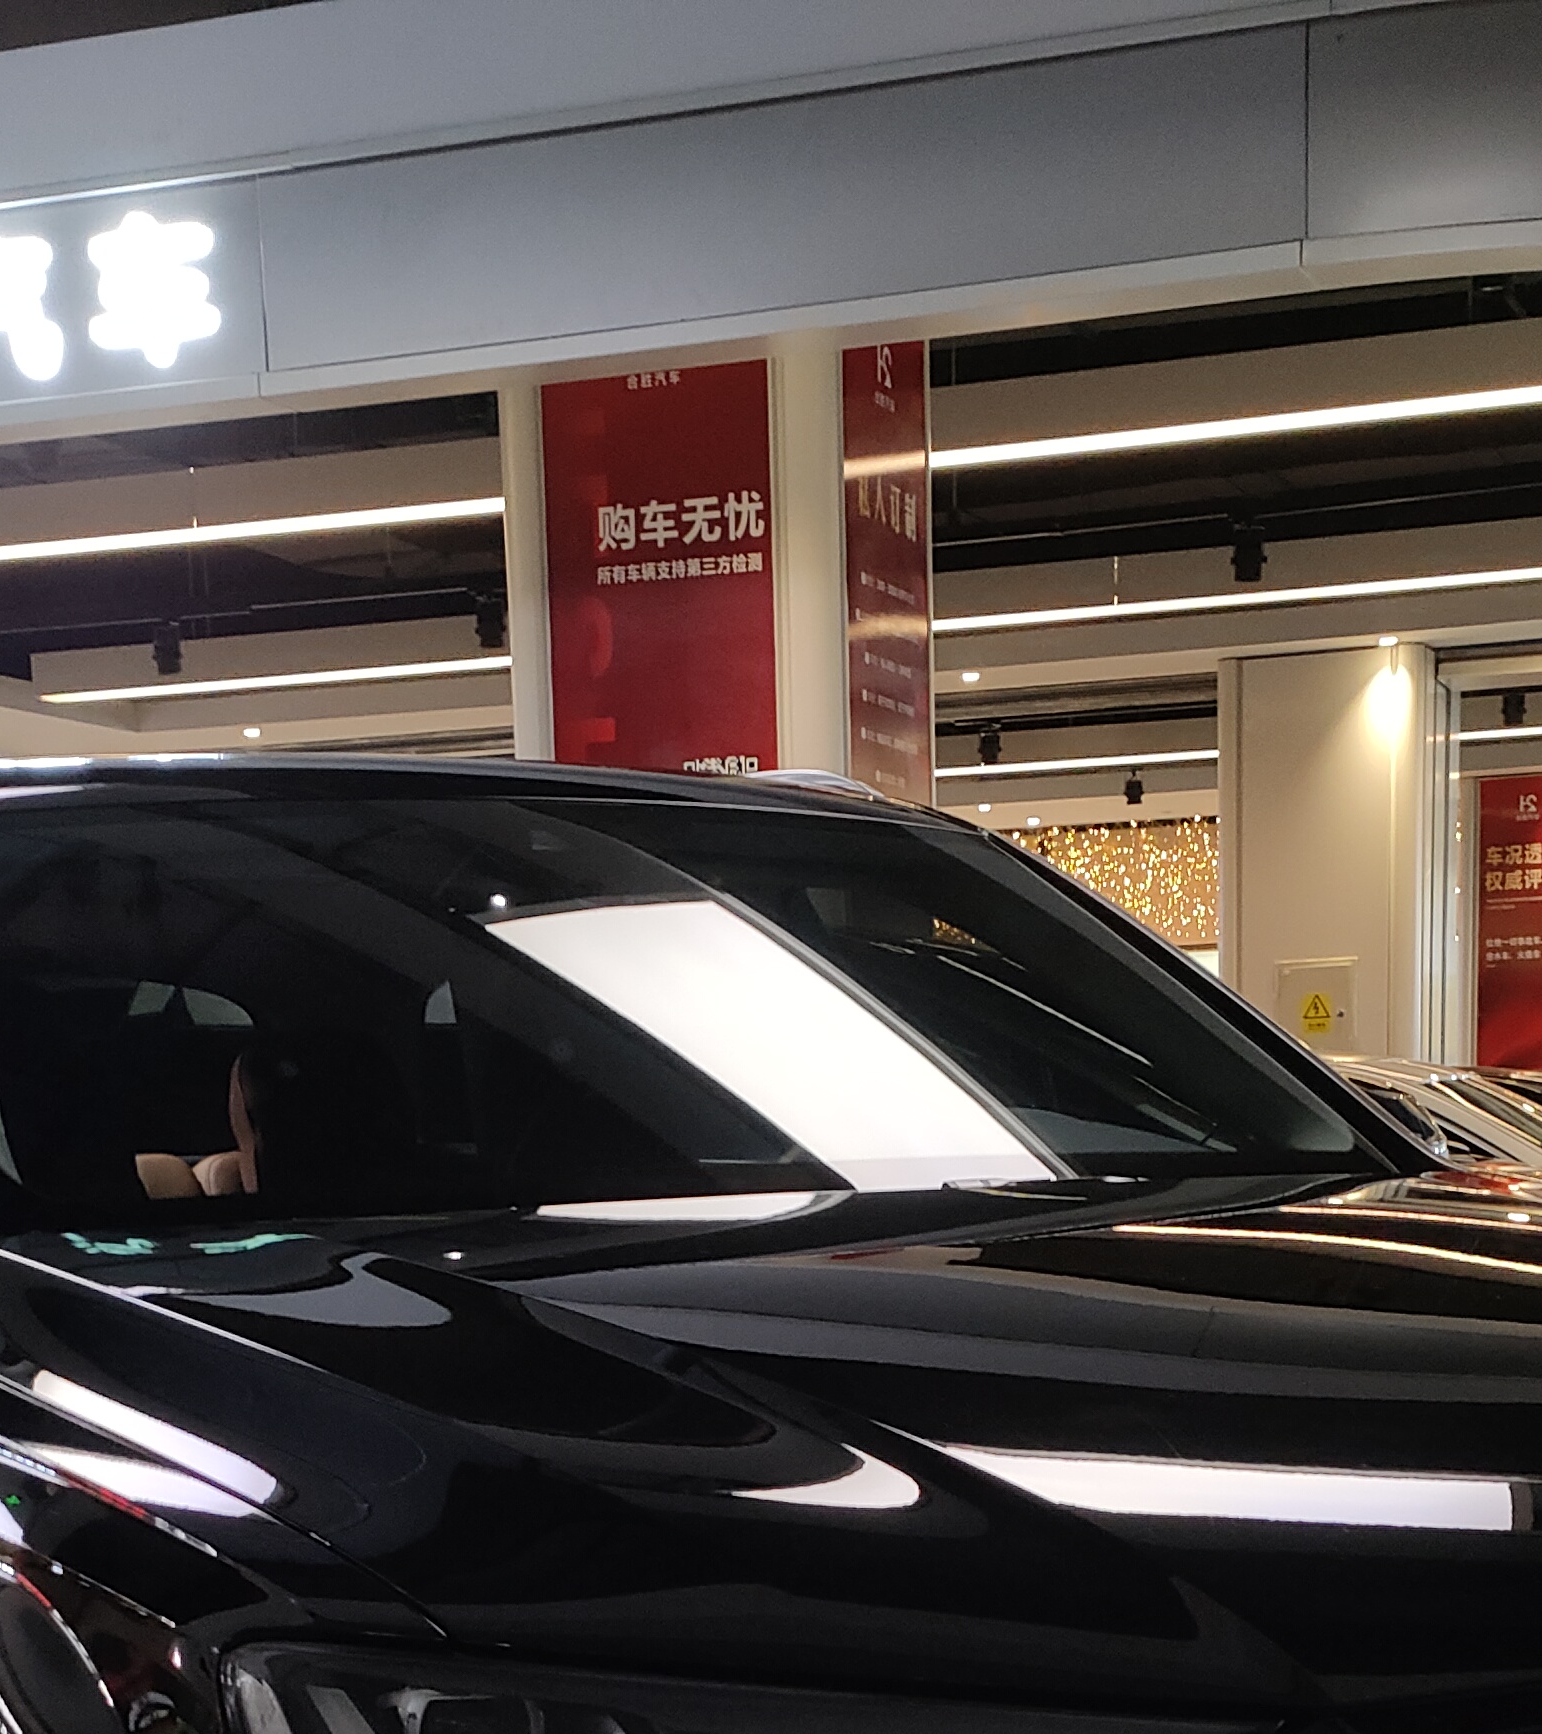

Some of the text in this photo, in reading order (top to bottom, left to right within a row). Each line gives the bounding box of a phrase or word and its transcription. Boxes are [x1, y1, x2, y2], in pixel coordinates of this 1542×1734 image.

[598, 490, 765, 551] 购车无忧
[597, 552, 763, 585] 所有车辆支持第三方检测
